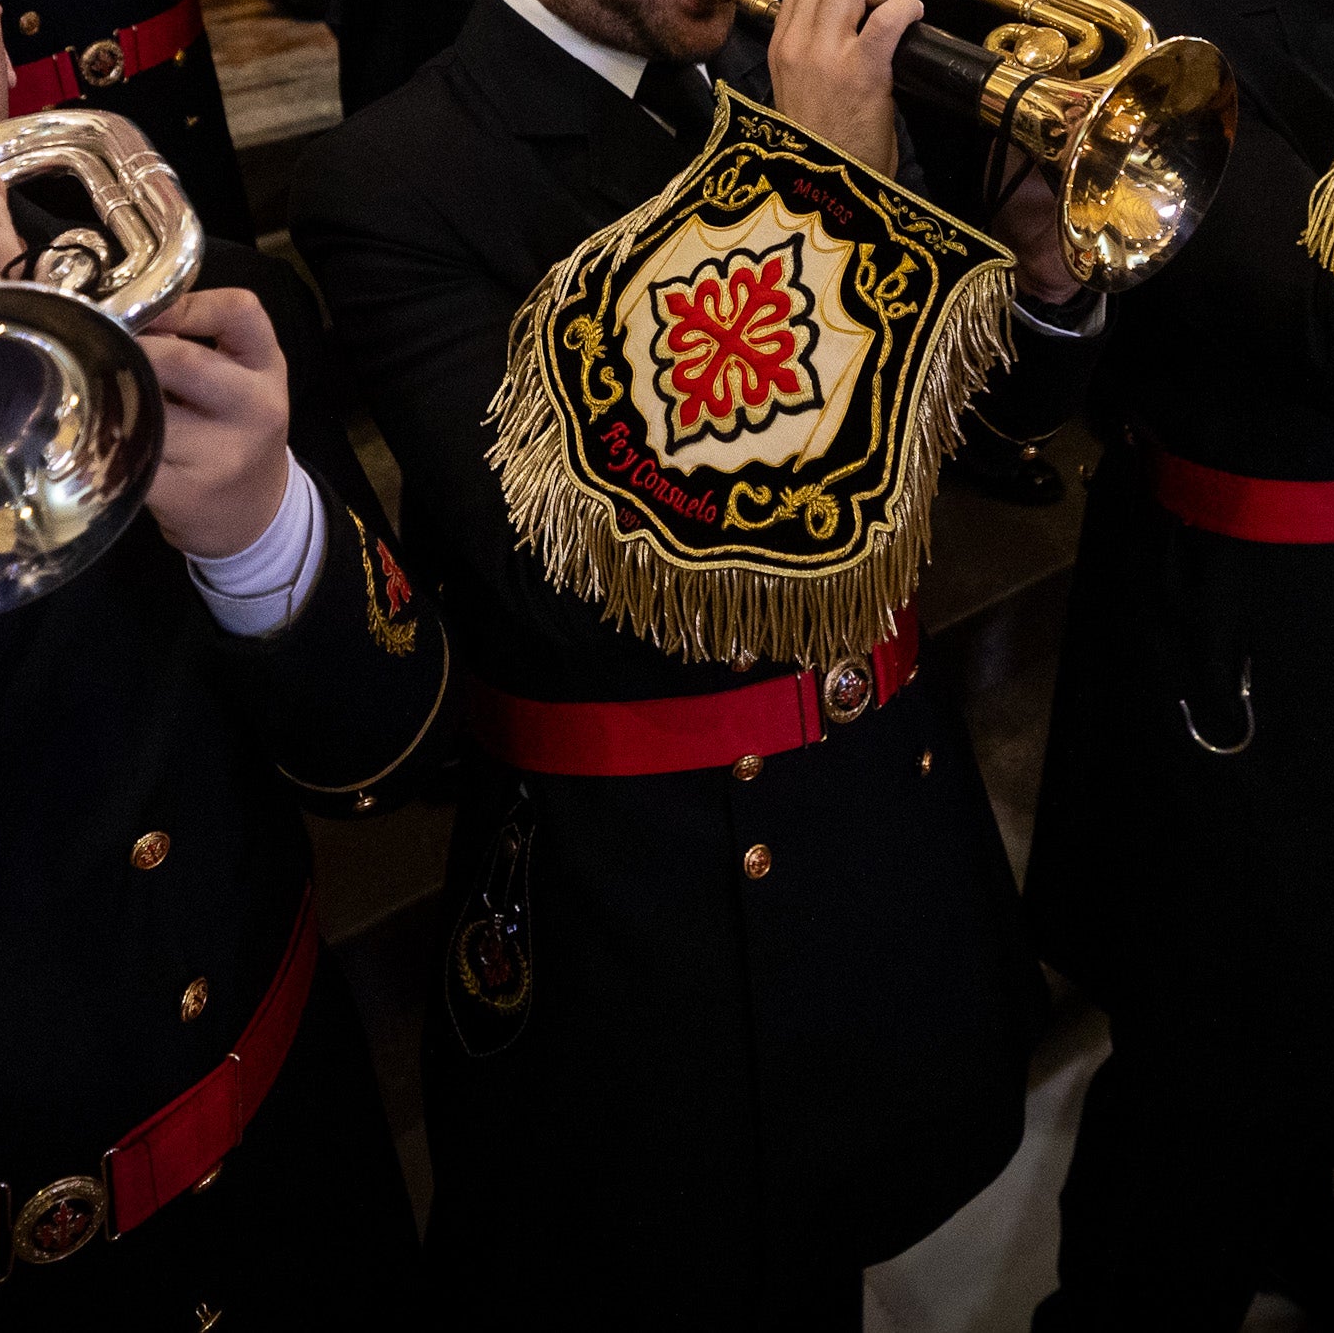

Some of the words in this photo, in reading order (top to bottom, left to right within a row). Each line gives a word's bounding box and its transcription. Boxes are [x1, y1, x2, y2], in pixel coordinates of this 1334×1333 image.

[792, 178, 853, 225] Martos
[600, 422, 630, 456] Fe
[607, 448, 639, 472] y
[630, 459, 717, 523] Consuelo
